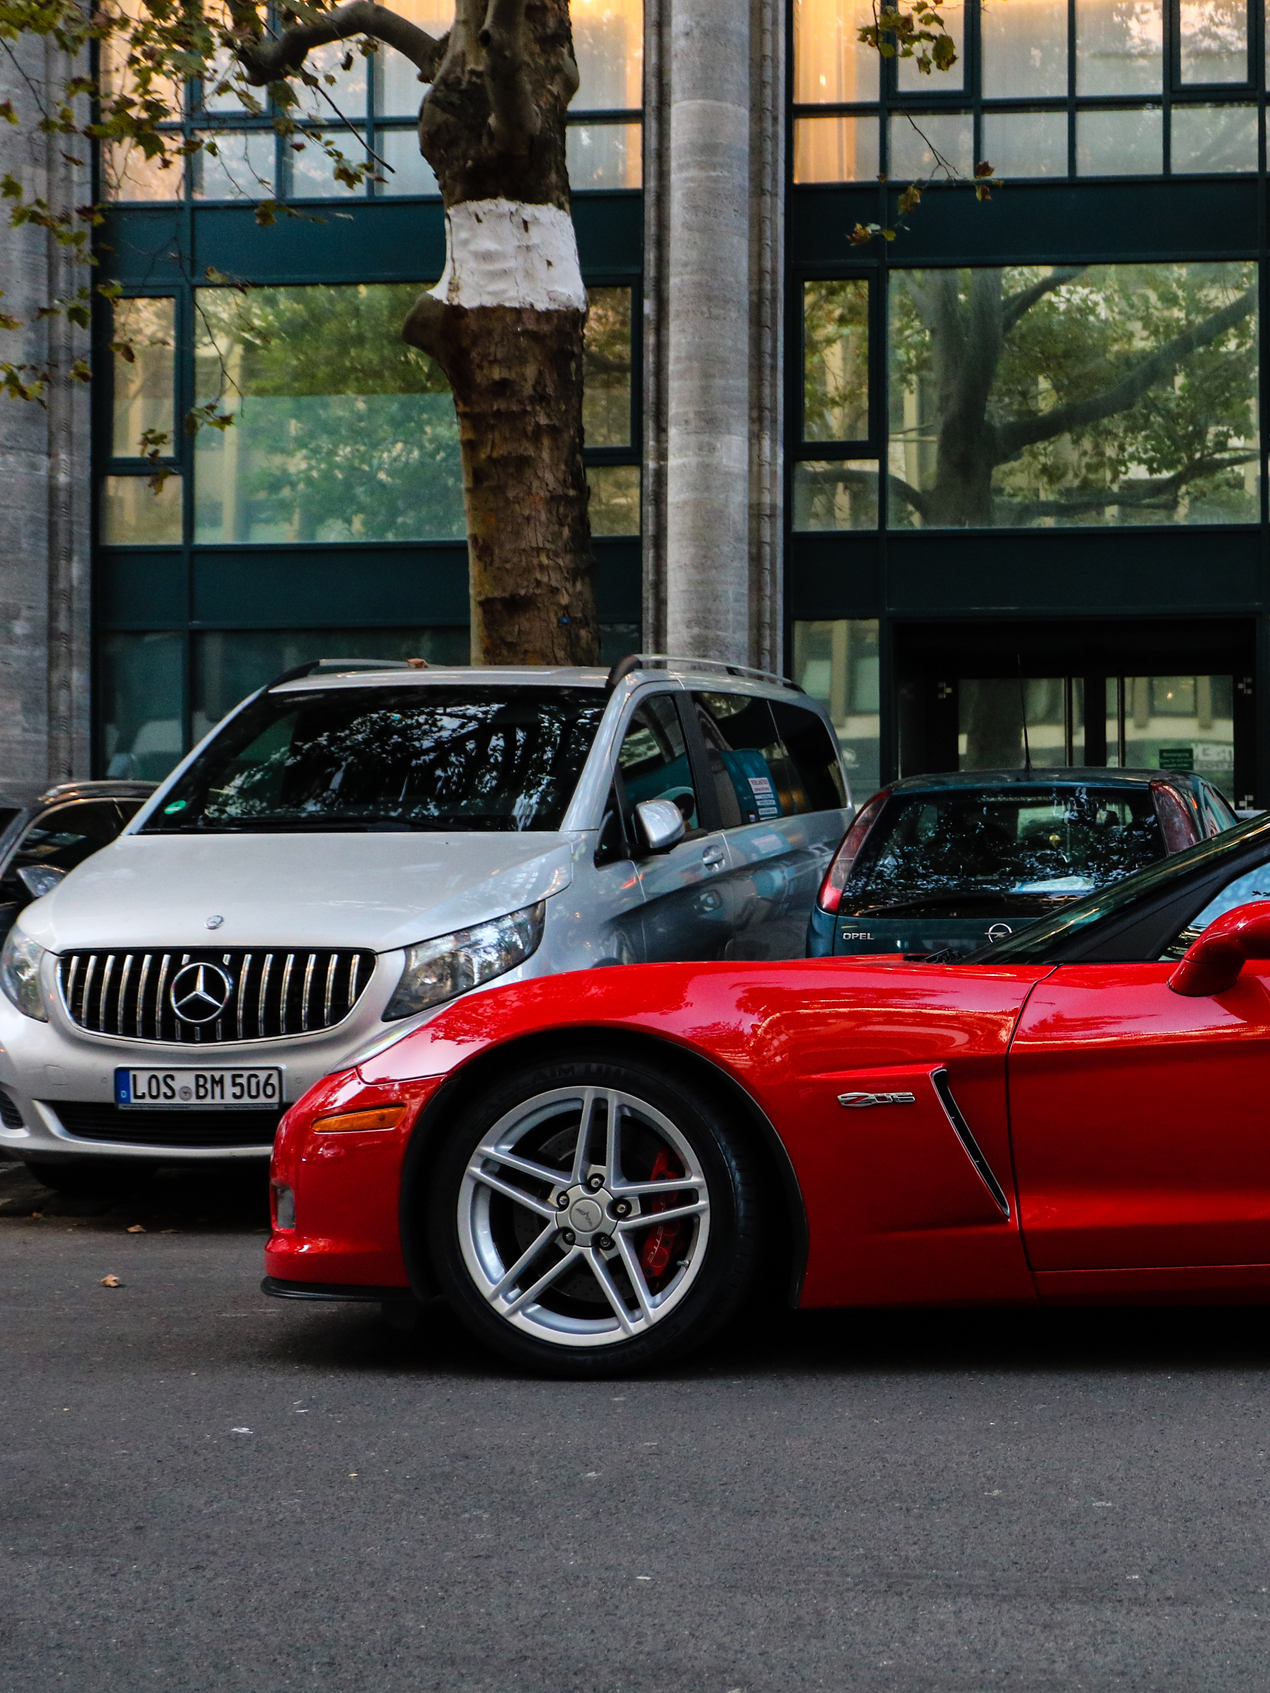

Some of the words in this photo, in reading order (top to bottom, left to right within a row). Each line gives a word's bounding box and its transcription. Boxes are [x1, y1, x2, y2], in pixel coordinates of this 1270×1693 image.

[842, 932, 875, 941] OPEL
[132, 1073, 176, 1100] LOS
[194, 1073, 224, 1100] BM
[230, 1073, 276, 1100] 506
